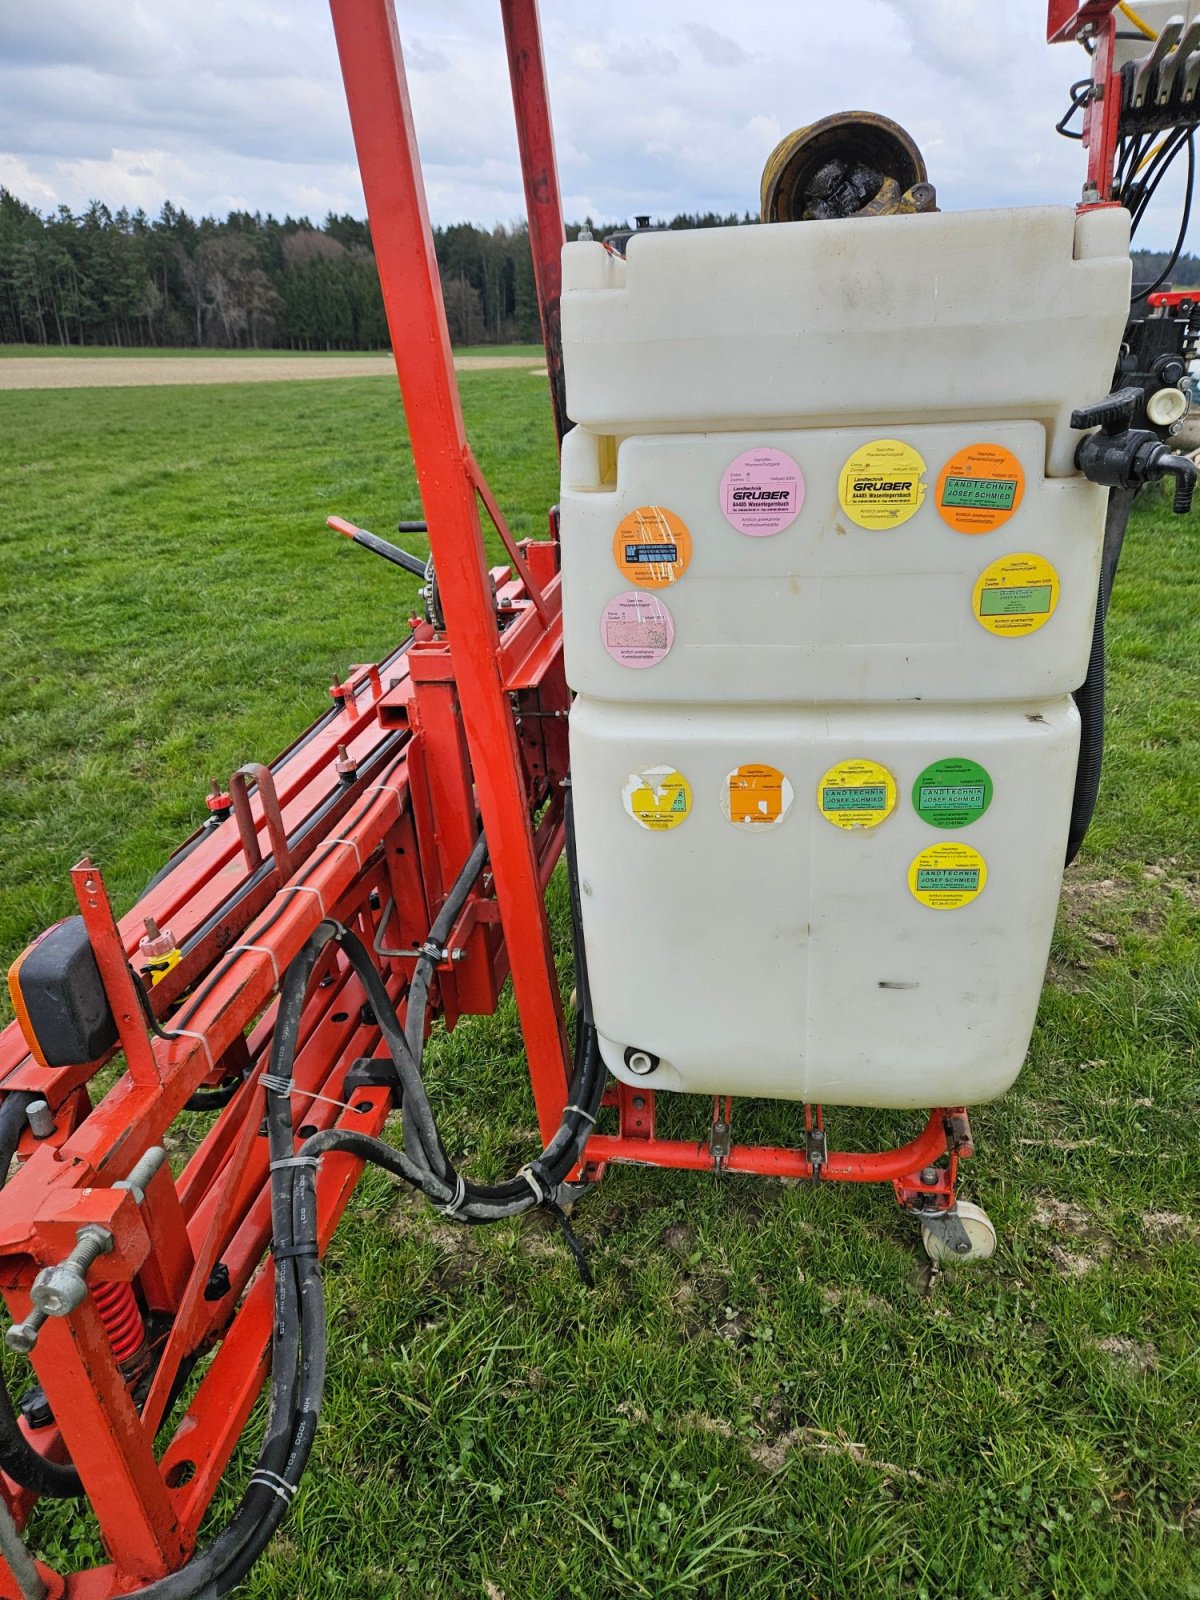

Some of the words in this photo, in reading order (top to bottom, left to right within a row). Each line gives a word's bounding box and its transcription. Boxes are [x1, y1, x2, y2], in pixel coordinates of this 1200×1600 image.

[853, 482, 912, 491] GRUBER
[948, 481, 1013, 490] LANDTECHNIK
[733, 491, 790, 500] GRUBER
[302, 1397, 311, 1414] HM
[294, 1420, 306, 1446] 1000
